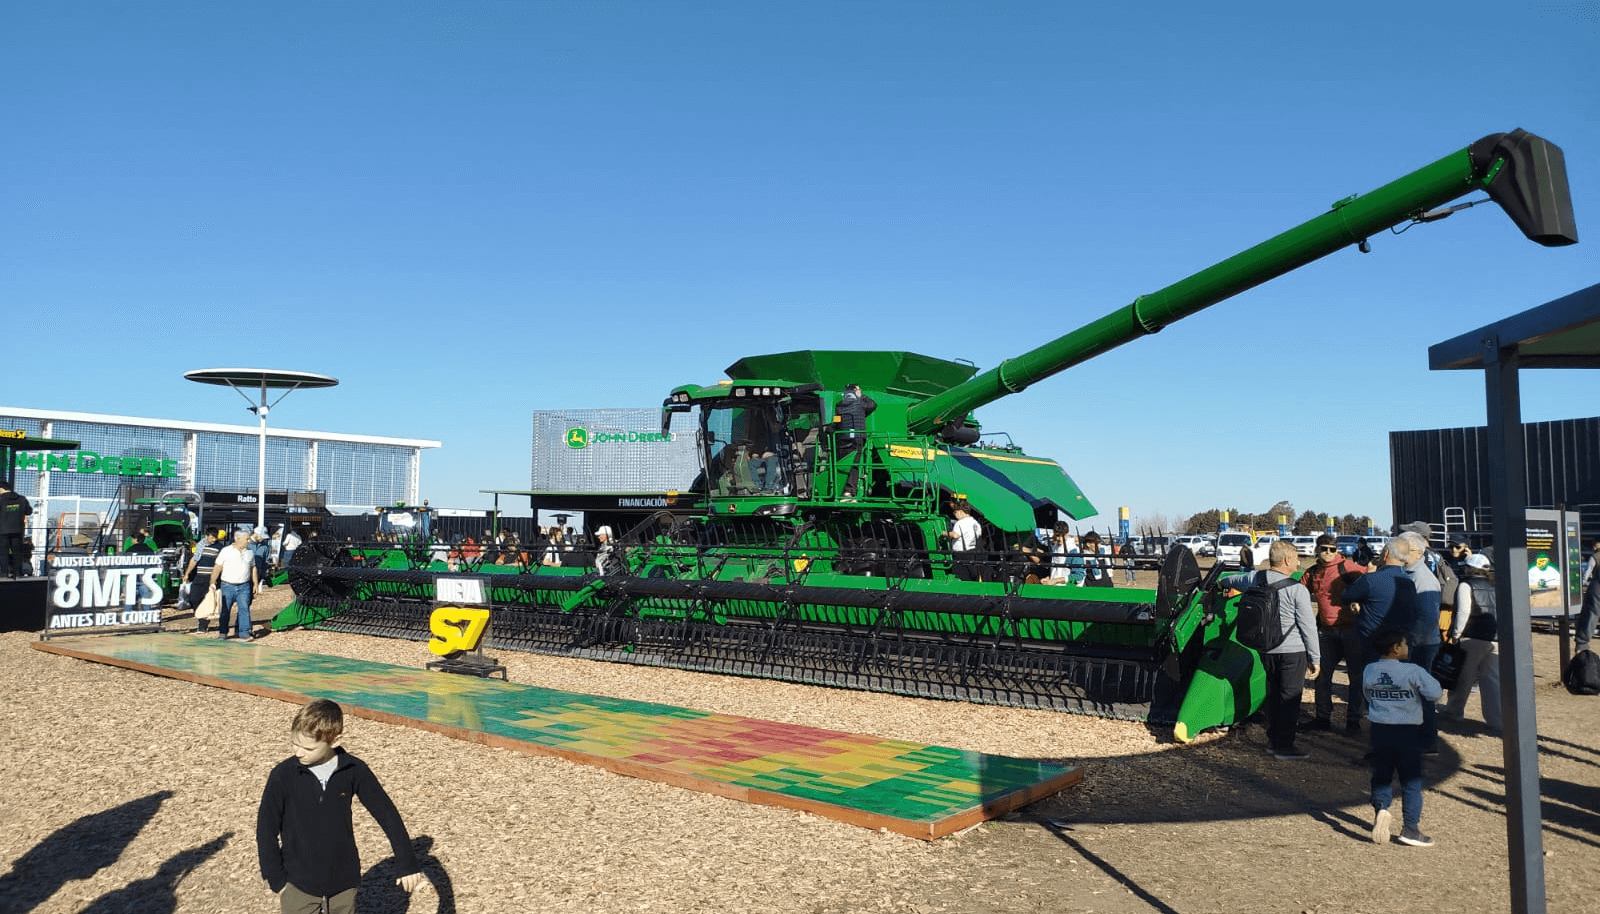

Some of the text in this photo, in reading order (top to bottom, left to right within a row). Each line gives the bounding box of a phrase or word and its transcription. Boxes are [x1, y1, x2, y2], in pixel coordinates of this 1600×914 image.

[592, 431, 671, 443] JOHN DEERE
[77, 450, 177, 477] DEERE
[237, 494, 257, 503] Ratto
[618, 496, 668, 507] FINANCIACIÓN
[53, 552, 162, 567] AJUSTES AUTOMÁTICOS
[53, 567, 163, 609] 8MTS
[50, 609, 161, 628] ANTES DEL CORTE
[428, 606, 490, 656] S7
